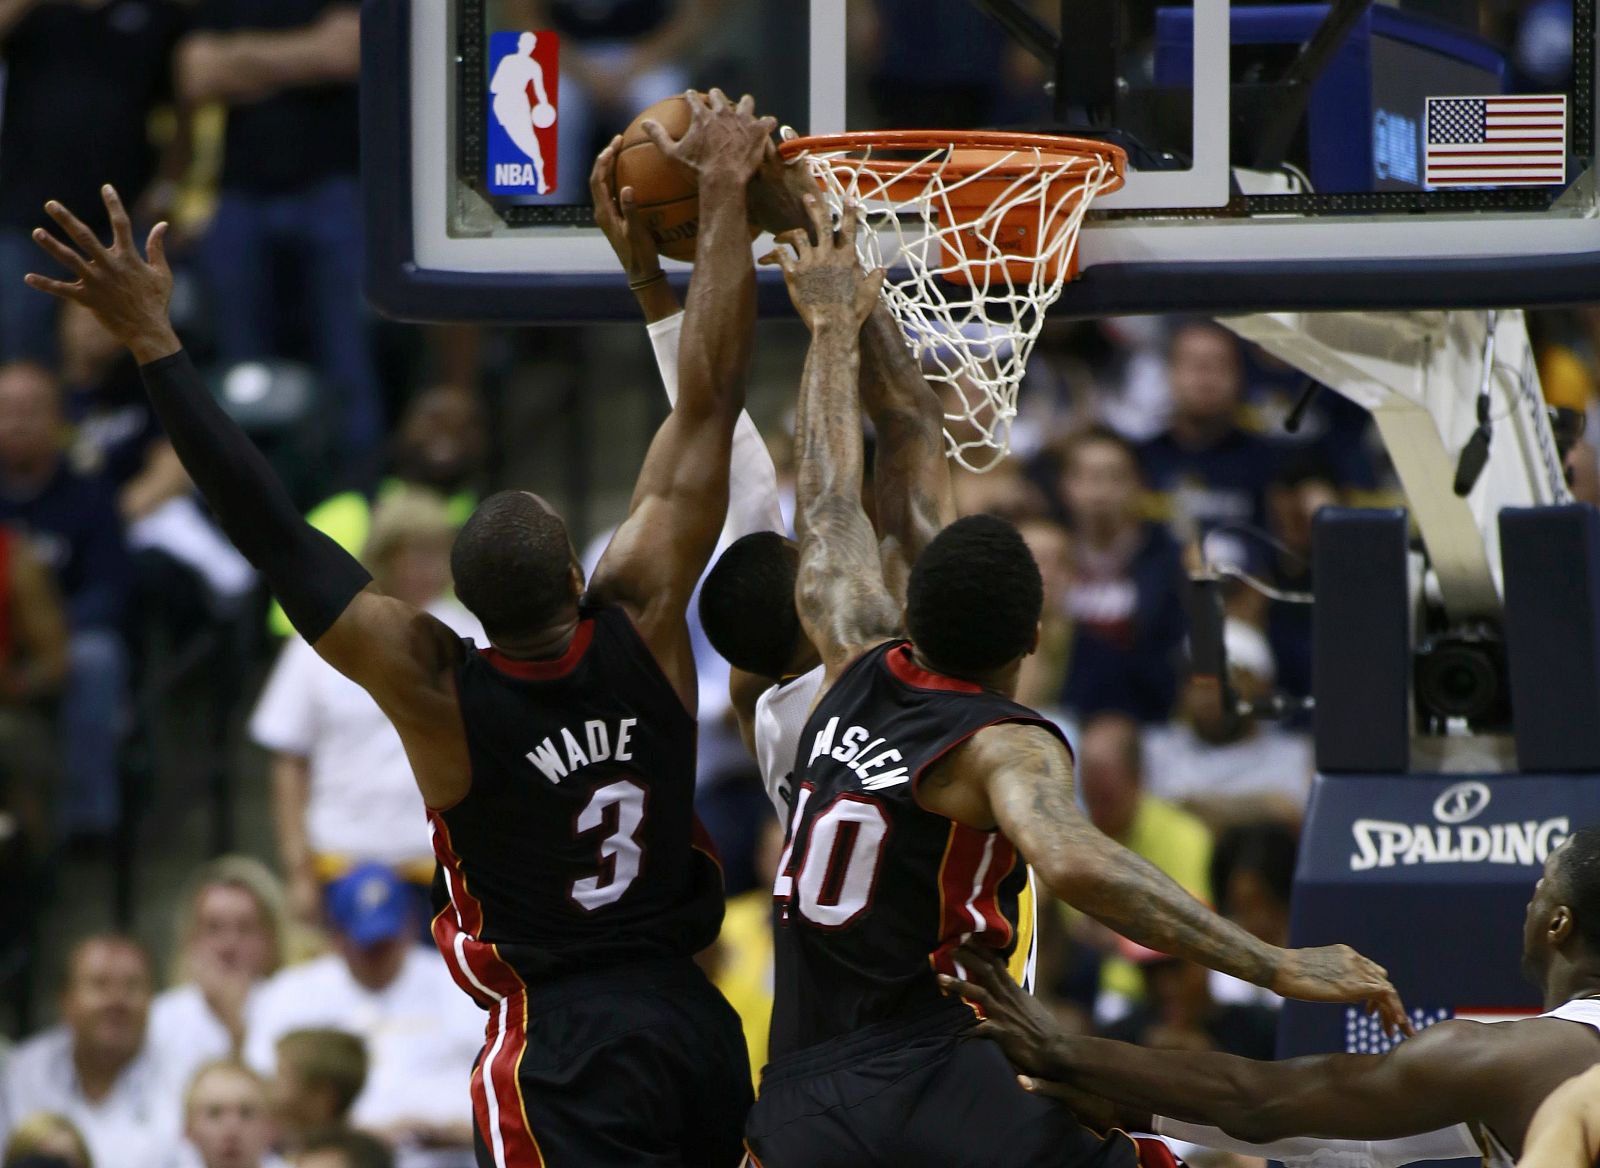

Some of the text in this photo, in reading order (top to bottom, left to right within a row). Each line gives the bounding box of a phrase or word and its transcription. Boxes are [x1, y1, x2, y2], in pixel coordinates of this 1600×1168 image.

[495, 163, 536, 186] NBA
[526, 718, 637, 784] WADE
[571, 779, 645, 911] 3
[1351, 817, 1570, 871] SPALDING
